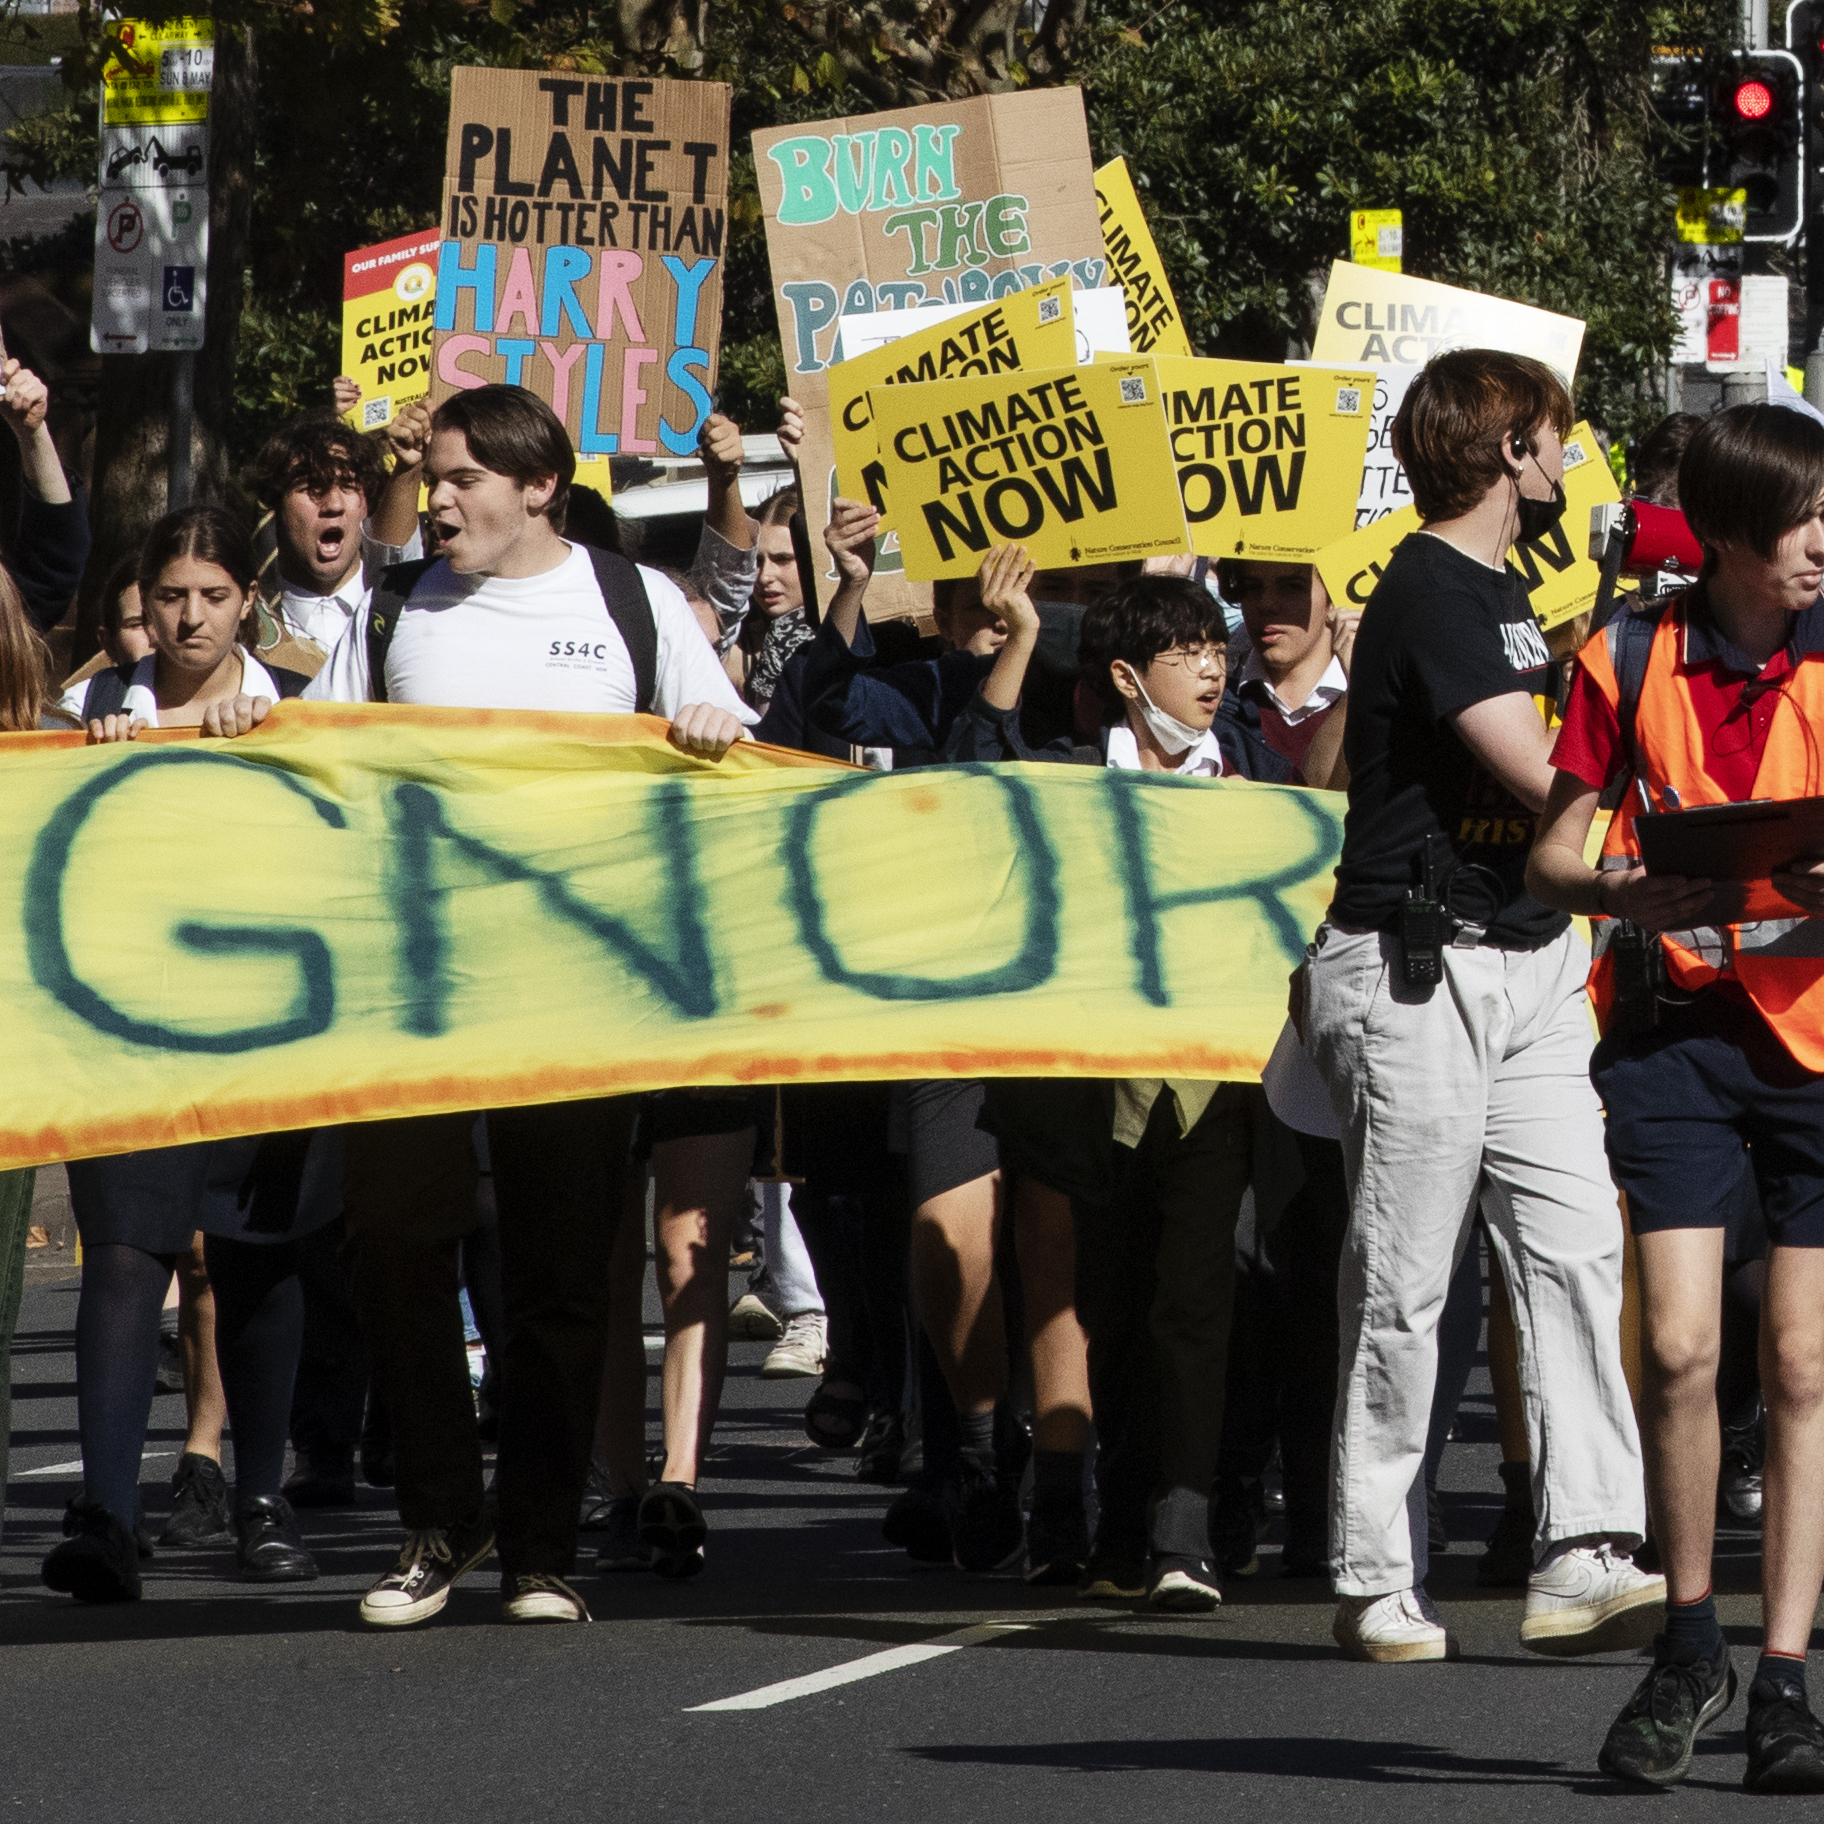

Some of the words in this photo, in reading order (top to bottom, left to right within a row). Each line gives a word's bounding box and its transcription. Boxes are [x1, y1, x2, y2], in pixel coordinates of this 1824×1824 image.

[160, 71, 180, 86] SUN
[190, 71, 211, 86] MAY
[538, 78, 654, 133] THE
[457, 123, 718, 206] PLANET
[767, 124, 963, 227] BURN
[449, 195, 478, 239] IS
[483, 197, 620, 248] HOTTER
[628, 202, 724, 257] THAN
[883, 193, 1031, 276] THE
[351, 257, 377, 274] OUR
[378, 245, 418, 267] FAMILY
[434, 240, 717, 348] HARRY
[1109, 366, 1133, 374] Order
[1134, 363, 1150, 372] yours
[1333, 374, 1349, 382] Order
[893, 374, 1088, 464] CLIMATE
[938, 409, 1106, 496] ACTION
[921, 445, 1119, 563] NOW
[1084, 545, 1108, 555] Nature
[1109, 541, 1153, 553] Conservation
[1154, 536, 1182, 548] Council
[1249, 543, 1270, 552] Nature
[1550, 599, 1575, 616] Nature
[548, 641, 607, 660] SS4C
